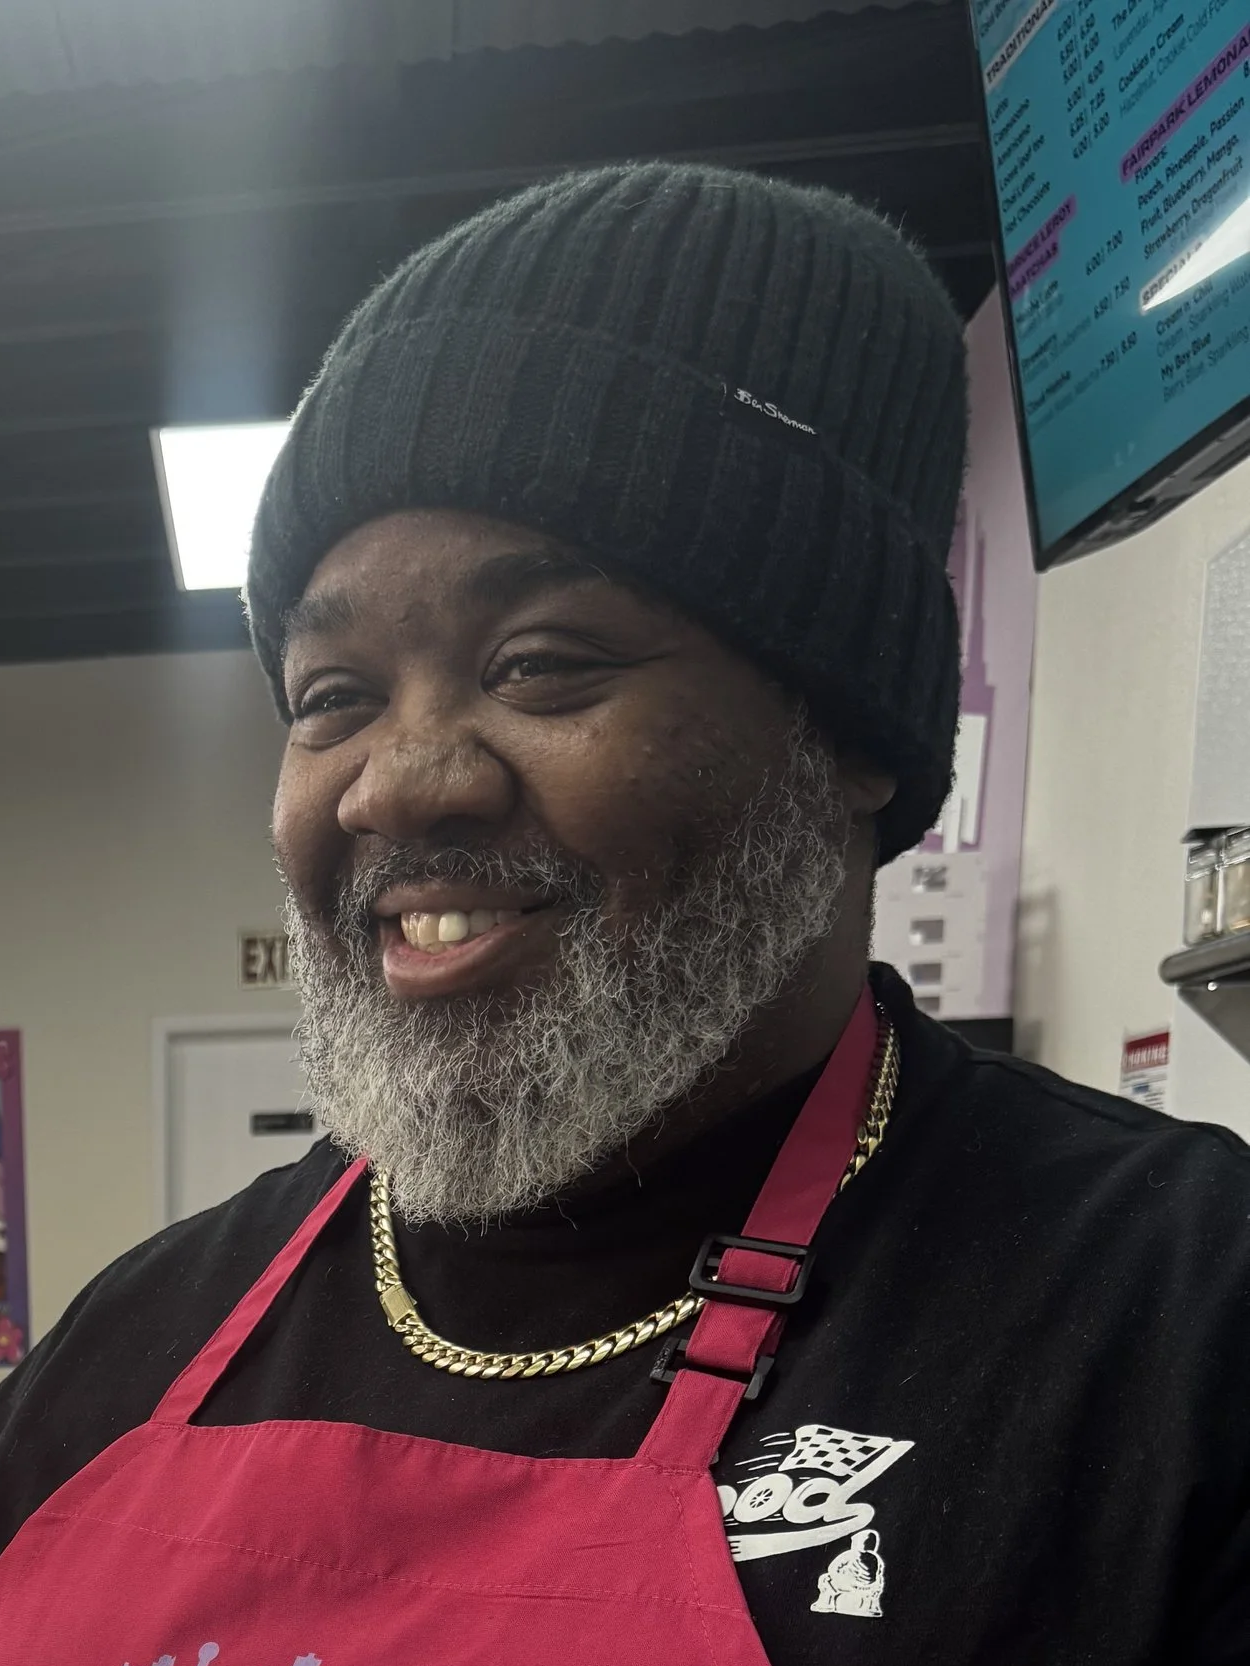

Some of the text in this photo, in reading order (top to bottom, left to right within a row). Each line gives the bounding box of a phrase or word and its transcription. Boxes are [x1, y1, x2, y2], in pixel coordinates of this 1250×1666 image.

[1118, 51, 1149, 92] Cookies
[1156, 14, 1185, 49] Cream
[1122, 101, 1185, 175] FAIRPARK
[1208, 96, 1245, 135] Passion
[1190, 155, 1245, 214] Dragonfruit
[242, 936, 292, 984] EXI
